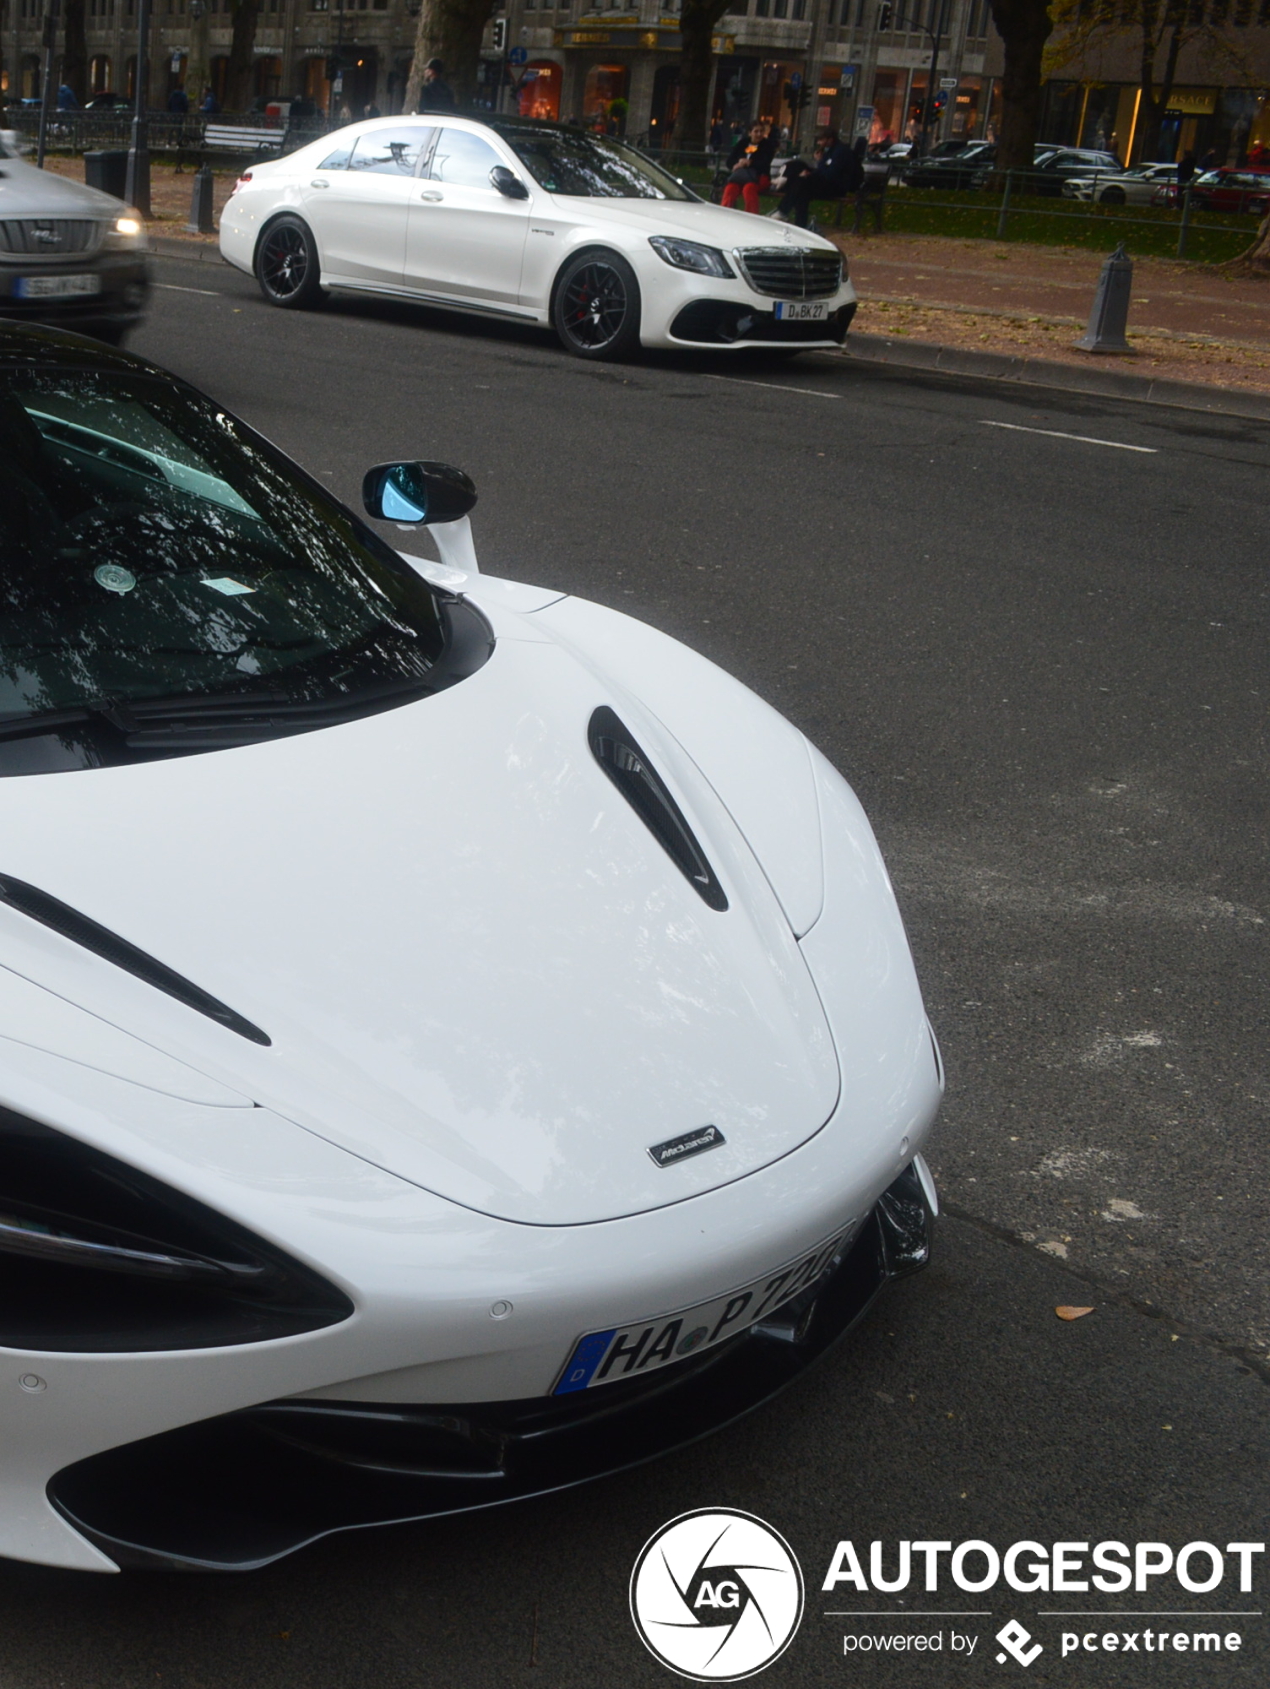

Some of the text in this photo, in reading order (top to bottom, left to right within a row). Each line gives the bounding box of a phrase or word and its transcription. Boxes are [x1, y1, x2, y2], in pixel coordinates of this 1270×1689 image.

[660, 1134, 714, 1160] McLaren
[597, 1234, 844, 1380] HA P 720
[570, 1368, 585, 1383] D
